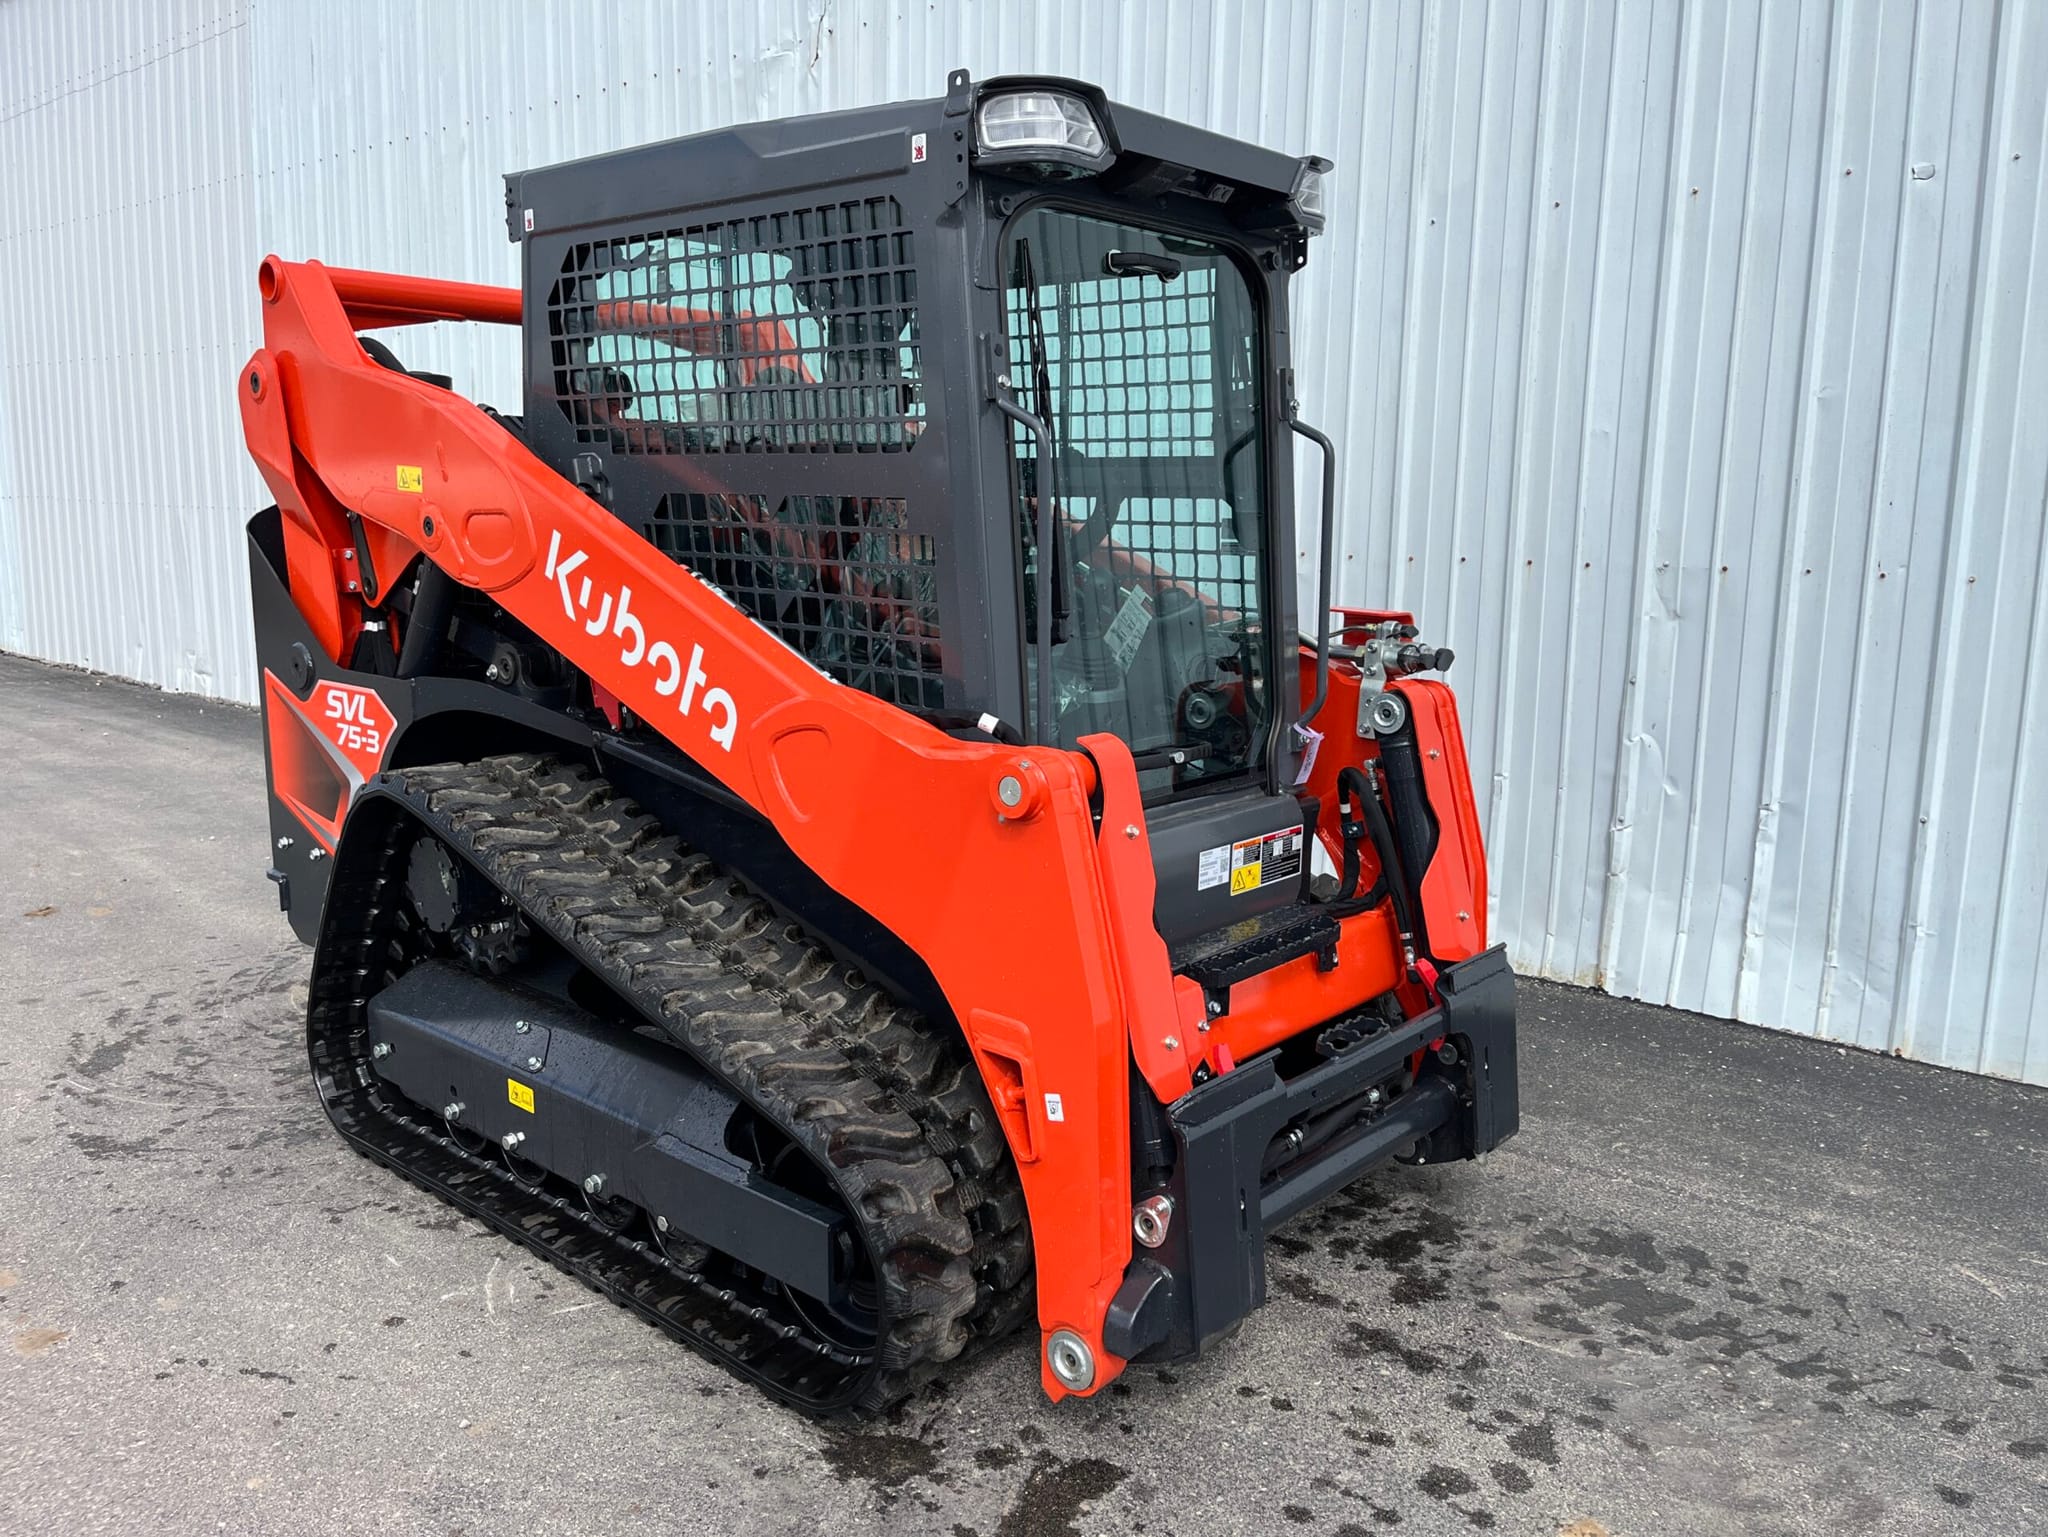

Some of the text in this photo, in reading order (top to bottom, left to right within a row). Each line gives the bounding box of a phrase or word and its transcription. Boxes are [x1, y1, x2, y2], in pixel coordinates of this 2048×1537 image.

[545, 529, 738, 752] Kubota
[325, 689, 375, 726] SVL
[336, 723, 380, 754] 75-3
